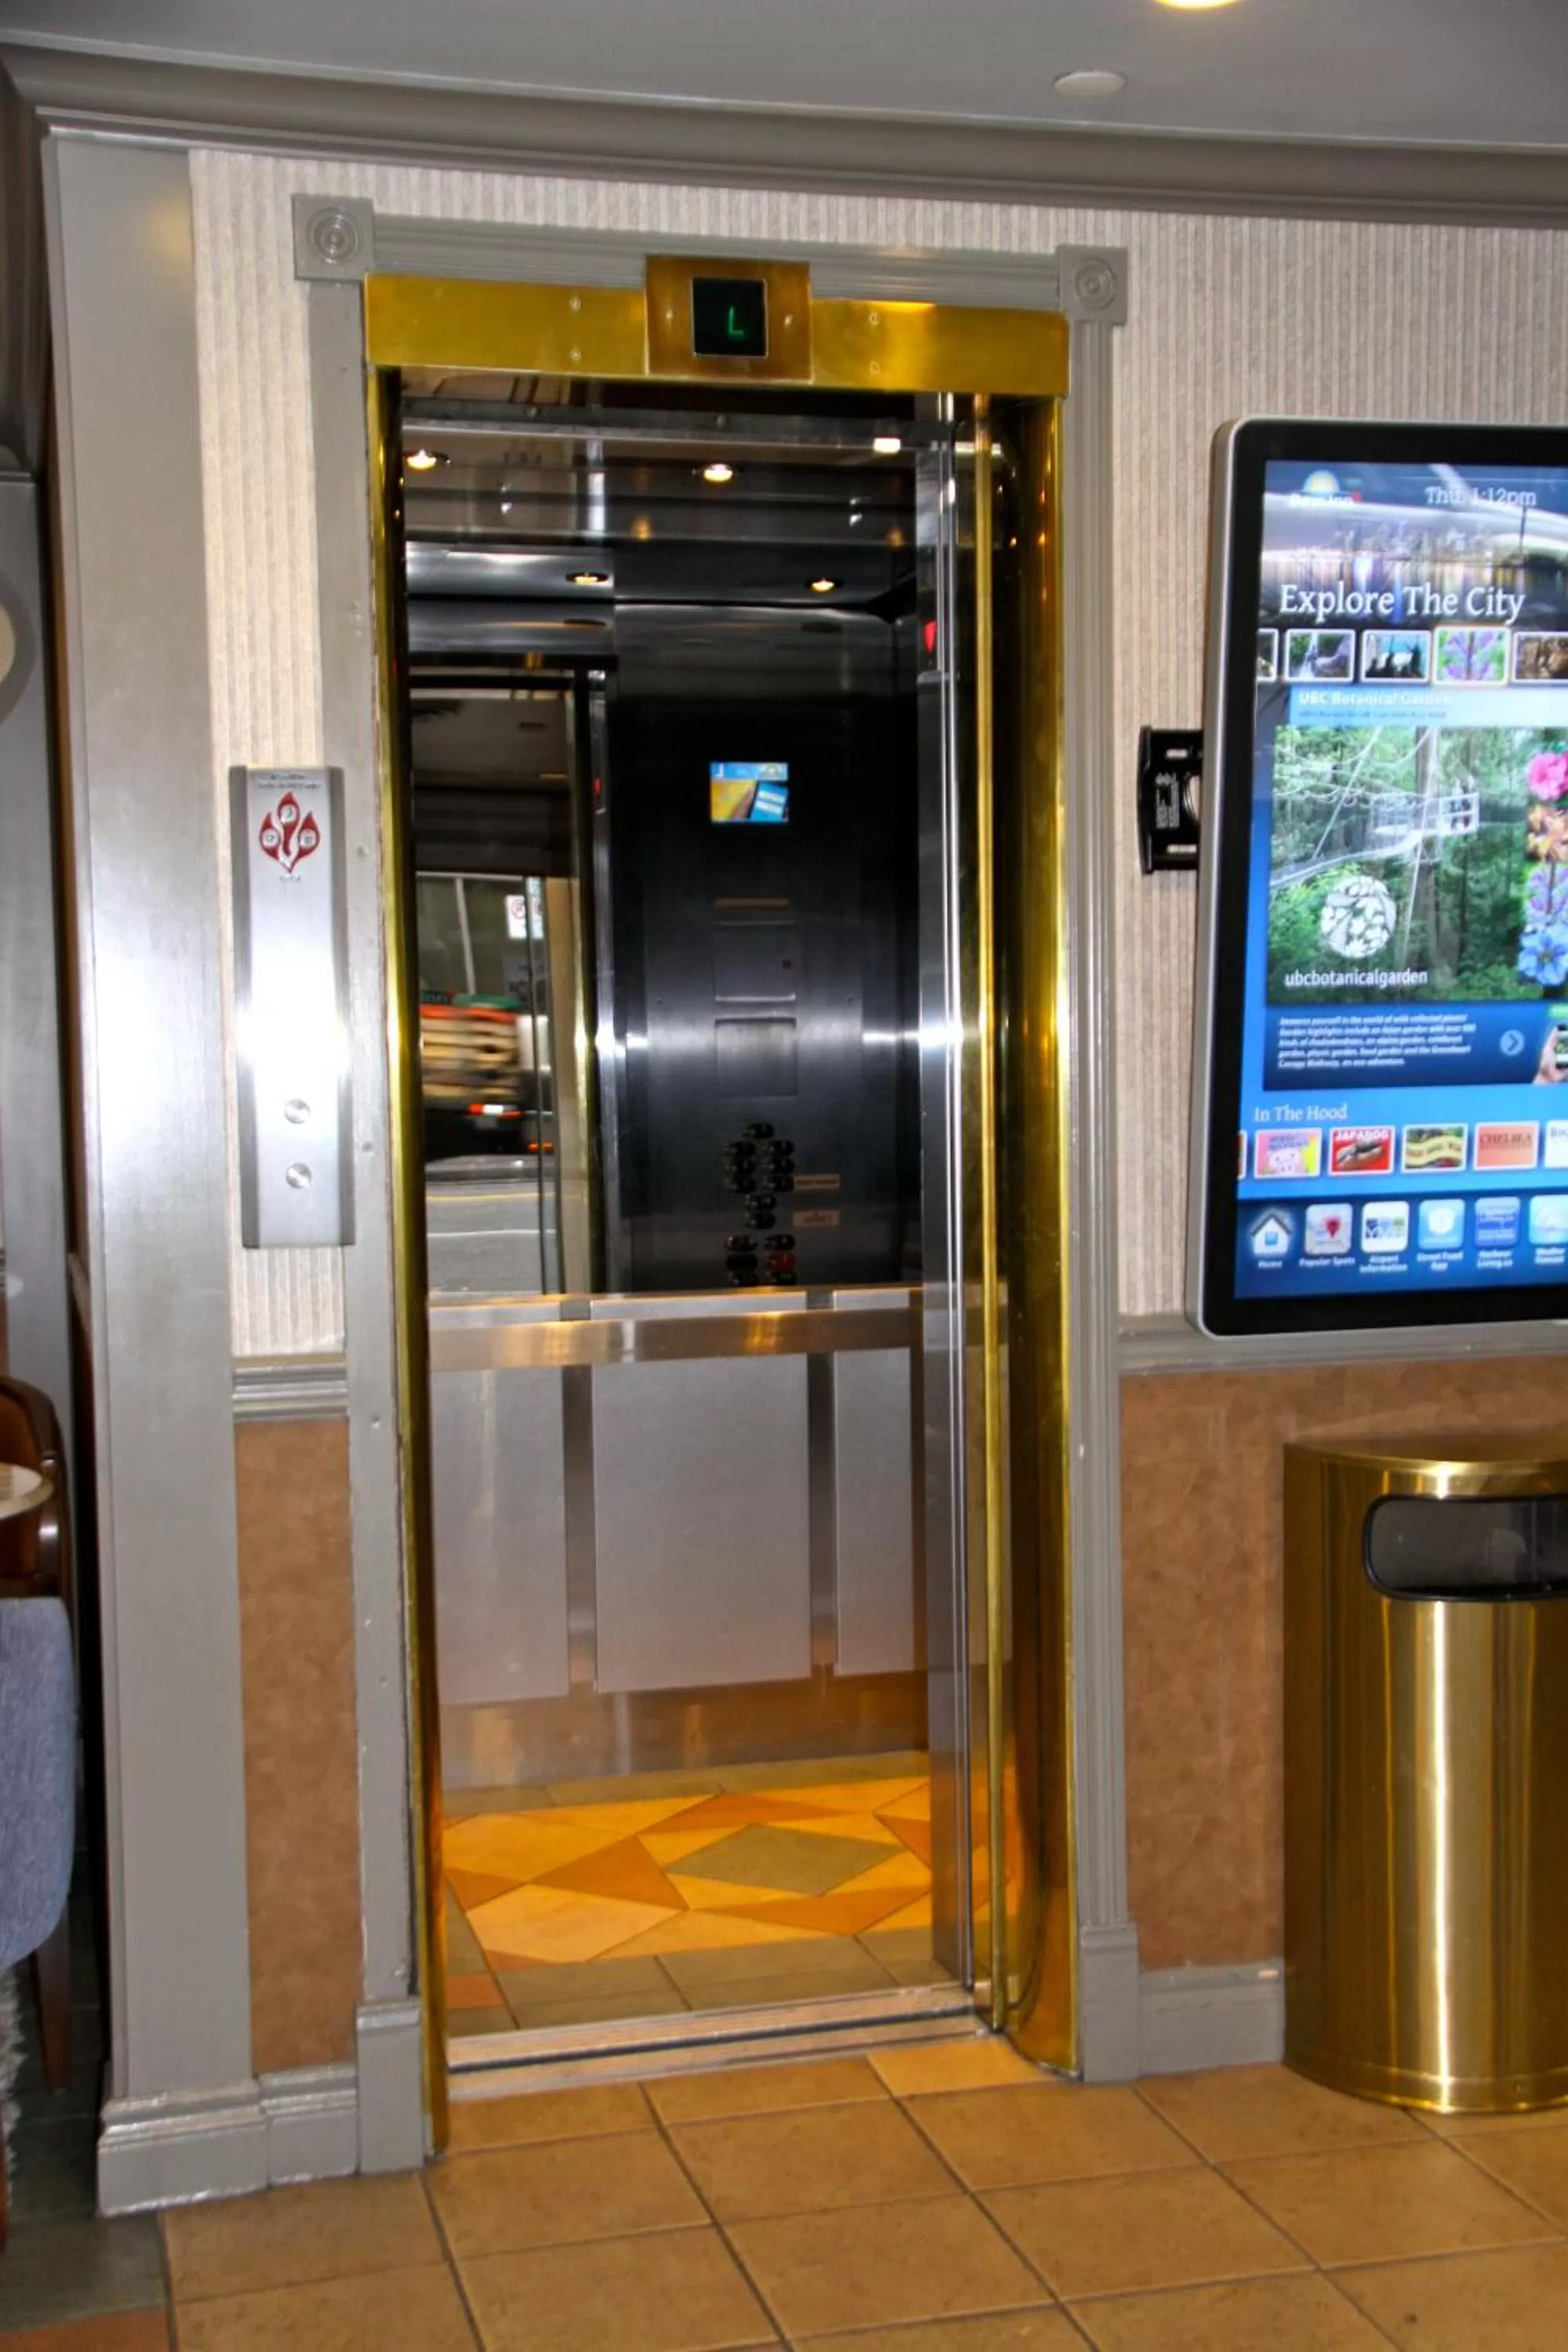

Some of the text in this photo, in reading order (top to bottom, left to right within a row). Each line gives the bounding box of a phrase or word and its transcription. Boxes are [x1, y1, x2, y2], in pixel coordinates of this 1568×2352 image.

[728, 305, 744, 336] L
[1279, 583, 1526, 626] Explore The City
[1284, 967, 1428, 990] ubcbotanicalgarden
[1254, 1101, 1348, 1122] In The Hood
